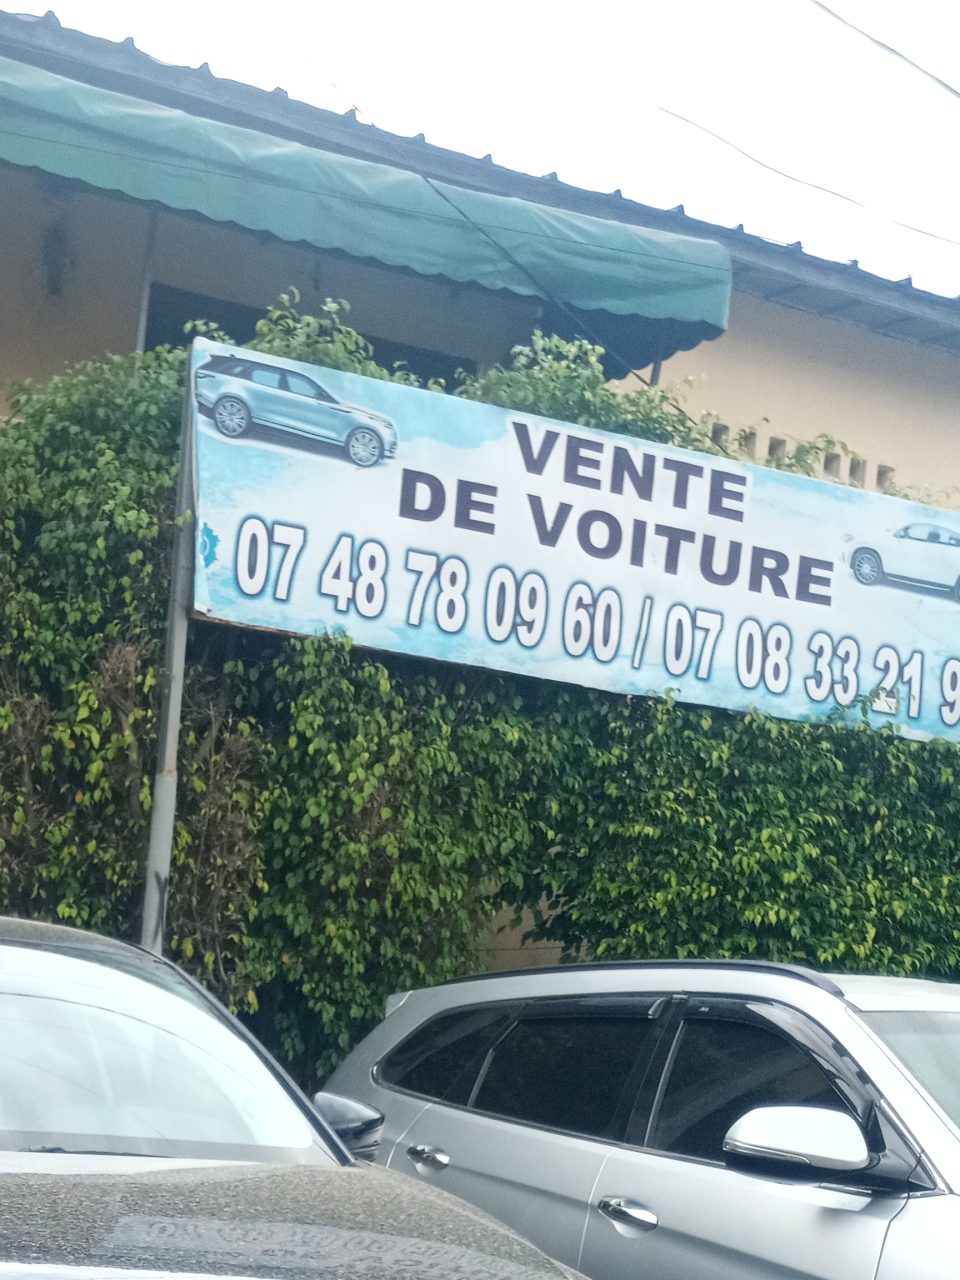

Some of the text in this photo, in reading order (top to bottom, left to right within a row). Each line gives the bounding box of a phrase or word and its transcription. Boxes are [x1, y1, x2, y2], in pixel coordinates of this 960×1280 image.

[399, 468, 834, 607] DE VOITURE
[511, 420, 747, 523] VENTE
[236, 515, 306, 602] 07
[319, 533, 387, 619] 48
[406, 549, 468, 633] 78
[485, 565, 548, 648] 09
[563, 581, 622, 663] 60
[632, 595, 653, 669] /
[664, 602, 723, 680] 07
[737, 617, 792, 696] 08
[805, 631, 859, 708] 33
[871, 644, 923, 720] 21
